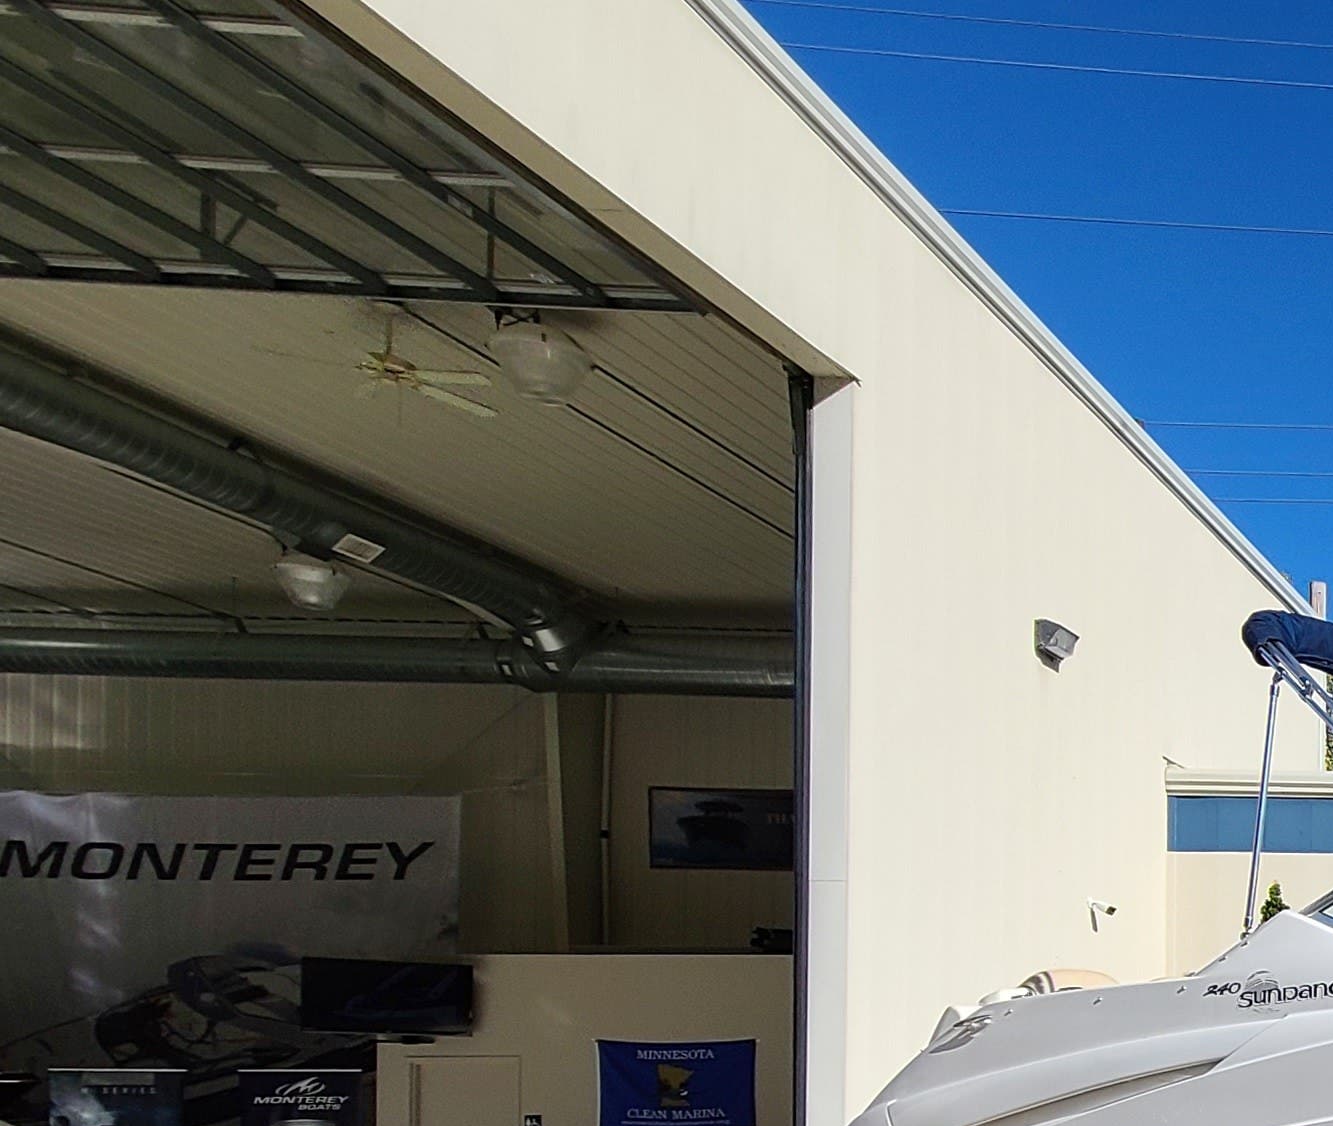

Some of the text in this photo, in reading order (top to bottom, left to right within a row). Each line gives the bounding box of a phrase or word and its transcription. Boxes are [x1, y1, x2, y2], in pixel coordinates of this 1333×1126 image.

[0, 841, 434, 881] MONTEREY
[1203, 983, 1241, 997] 240
[636, 1049, 715, 1060] MINNESOTA
[253, 1096, 349, 1105] MONTEREY
[298, 1103, 341, 1111] BOATS
[627, 1107, 726, 1120] CLEAN MARINA
